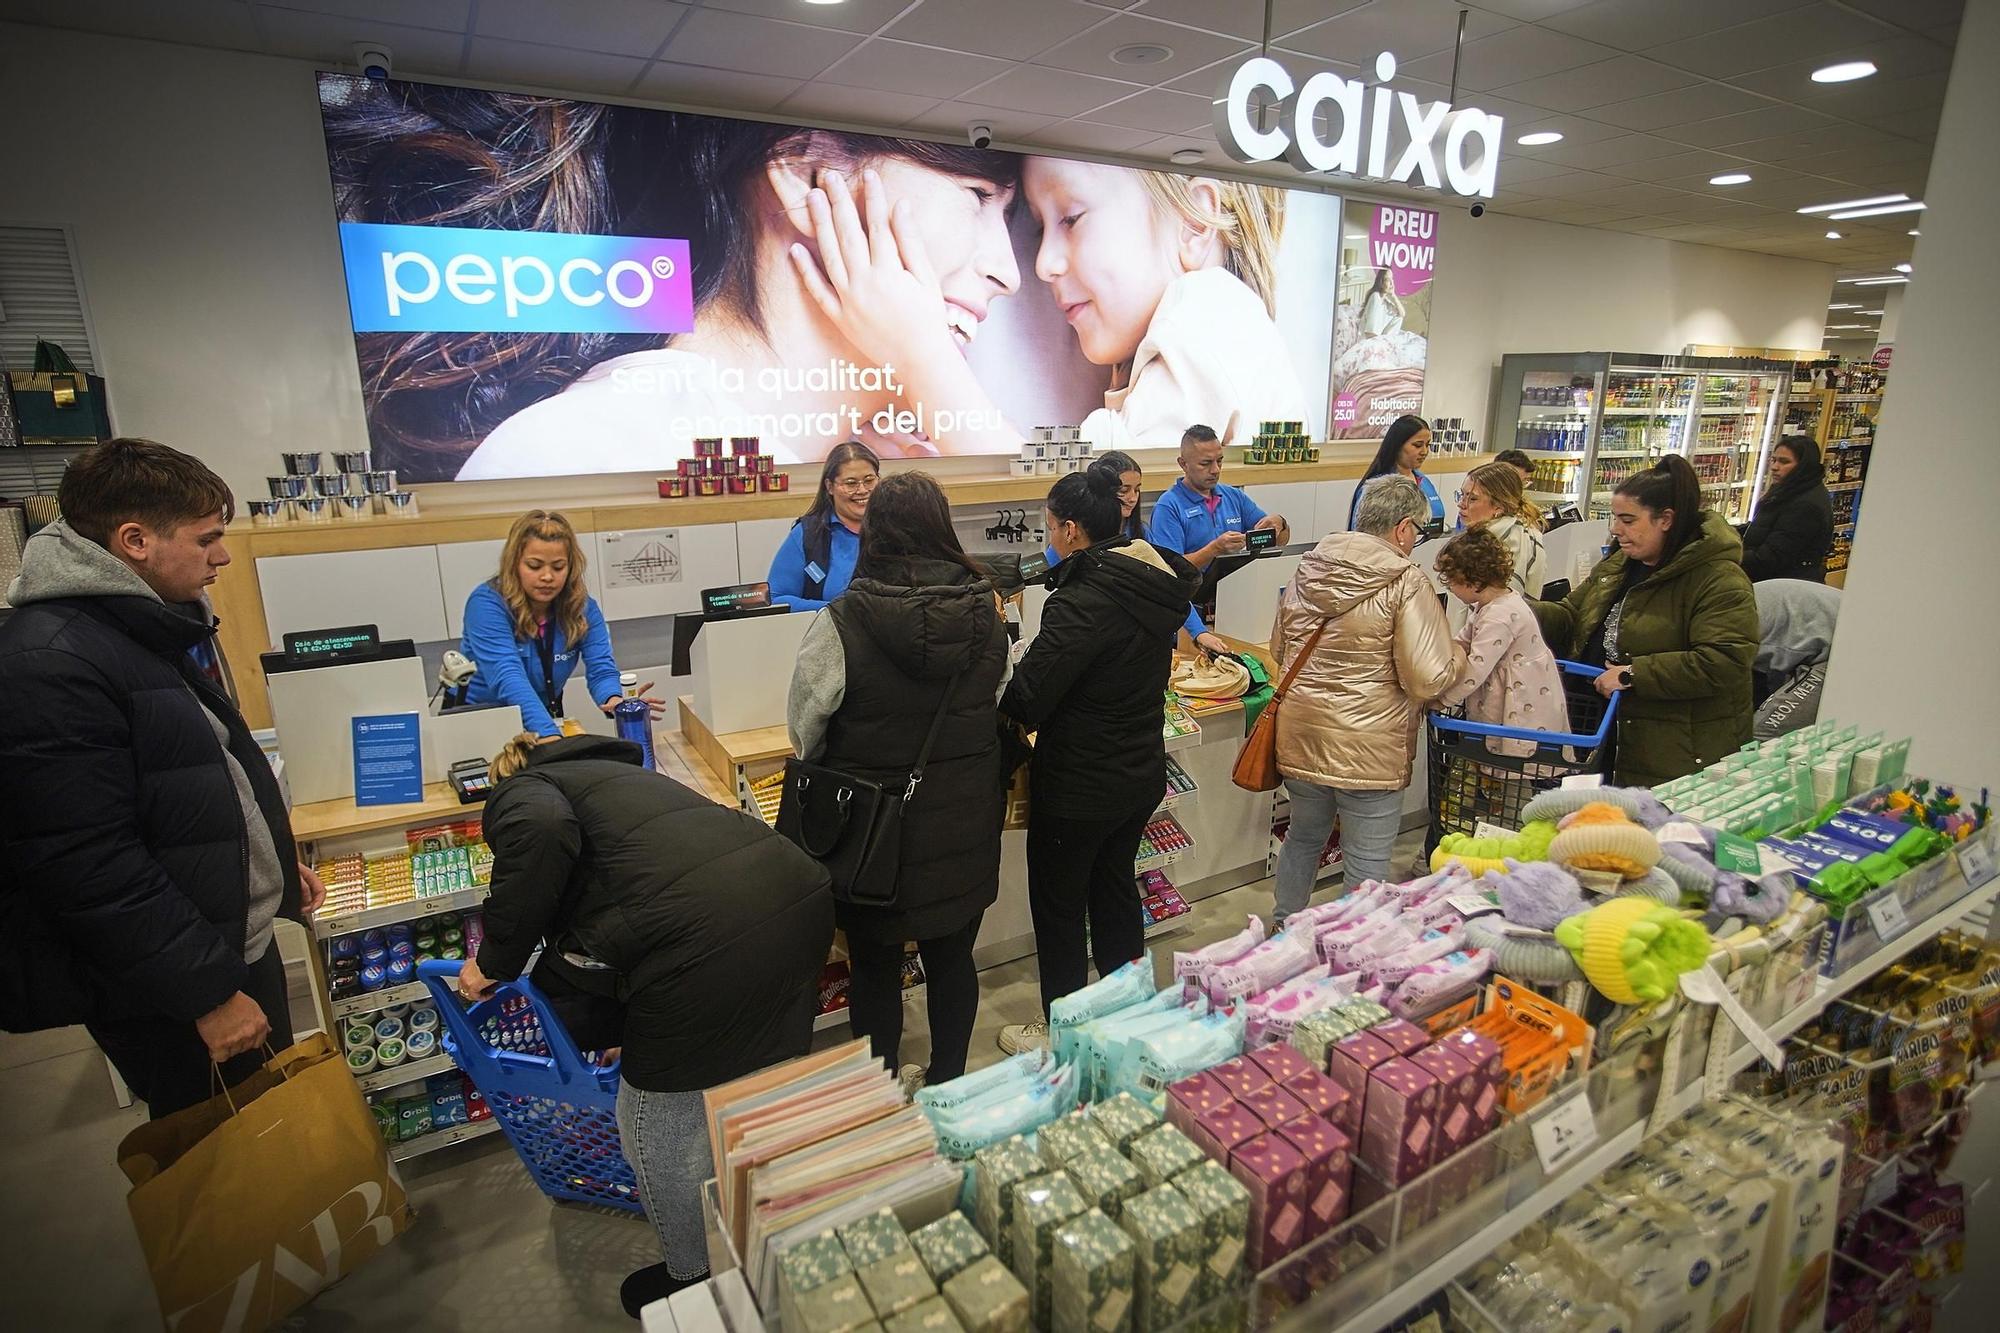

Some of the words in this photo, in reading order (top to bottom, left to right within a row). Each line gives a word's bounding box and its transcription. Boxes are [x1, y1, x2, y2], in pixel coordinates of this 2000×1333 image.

[1225, 51, 1503, 198] caixa
[1380, 206, 1434, 239] PREU
[1374, 241, 1434, 271] WOW!
[382, 251, 655, 317] pepco
[610, 361, 697, 393] sent
[711, 358, 745, 392] la
[757, 358, 904, 400] qualitat,
[1335, 409, 1355, 421] 25.01
[1370, 397, 1417, 410] Habitació
[872, 402, 923, 433] del
[934, 407, 1002, 440] preu
[1368, 412, 1400, 426] acollid
[1793, 673, 1822, 700] NEW
[1765, 699, 1800, 728] YORK
[817, 977, 850, 1009] Maltese
[402, 1105, 430, 1119] Orbit
[436, 1093, 463, 1105] Orbit
[378, 1115, 397, 1126] rbit
